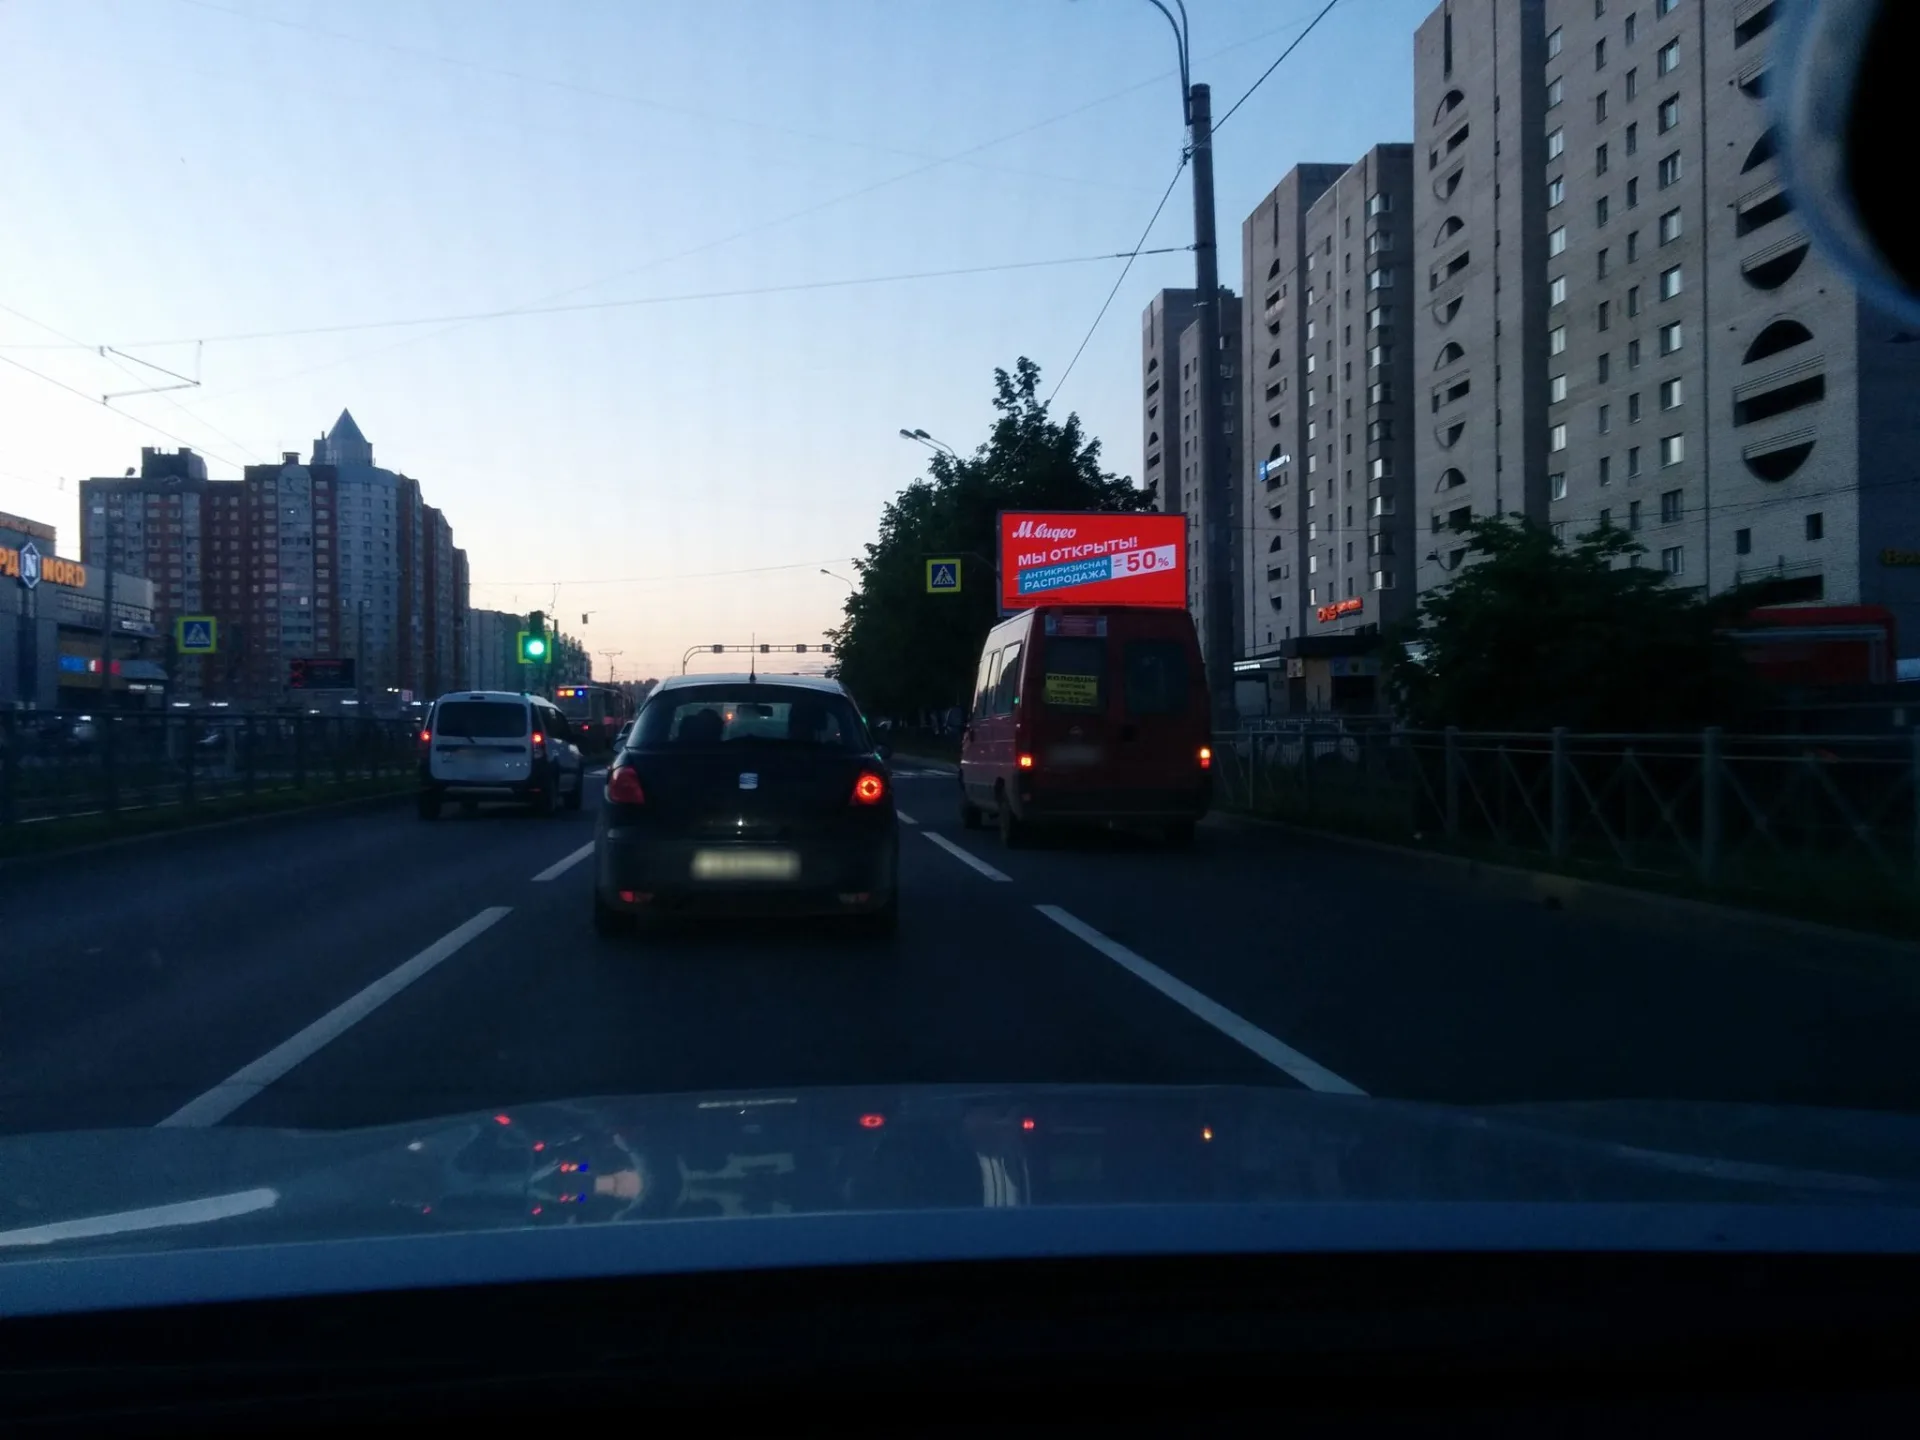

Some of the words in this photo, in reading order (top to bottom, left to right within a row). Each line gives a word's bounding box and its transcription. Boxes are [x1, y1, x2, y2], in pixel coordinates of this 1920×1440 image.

[1012, 521, 1076, 541] М.видео
[1018, 552, 1046, 566] МЫ
[1050, 537, 1138, 560] ОТКРЫТЫ!
[42, 557, 86, 588] NORD
[1024, 569, 1107, 590] РАСПРОДАЖА
[1025, 559, 1108, 580] АНТИКРИЗИСНАЯ
